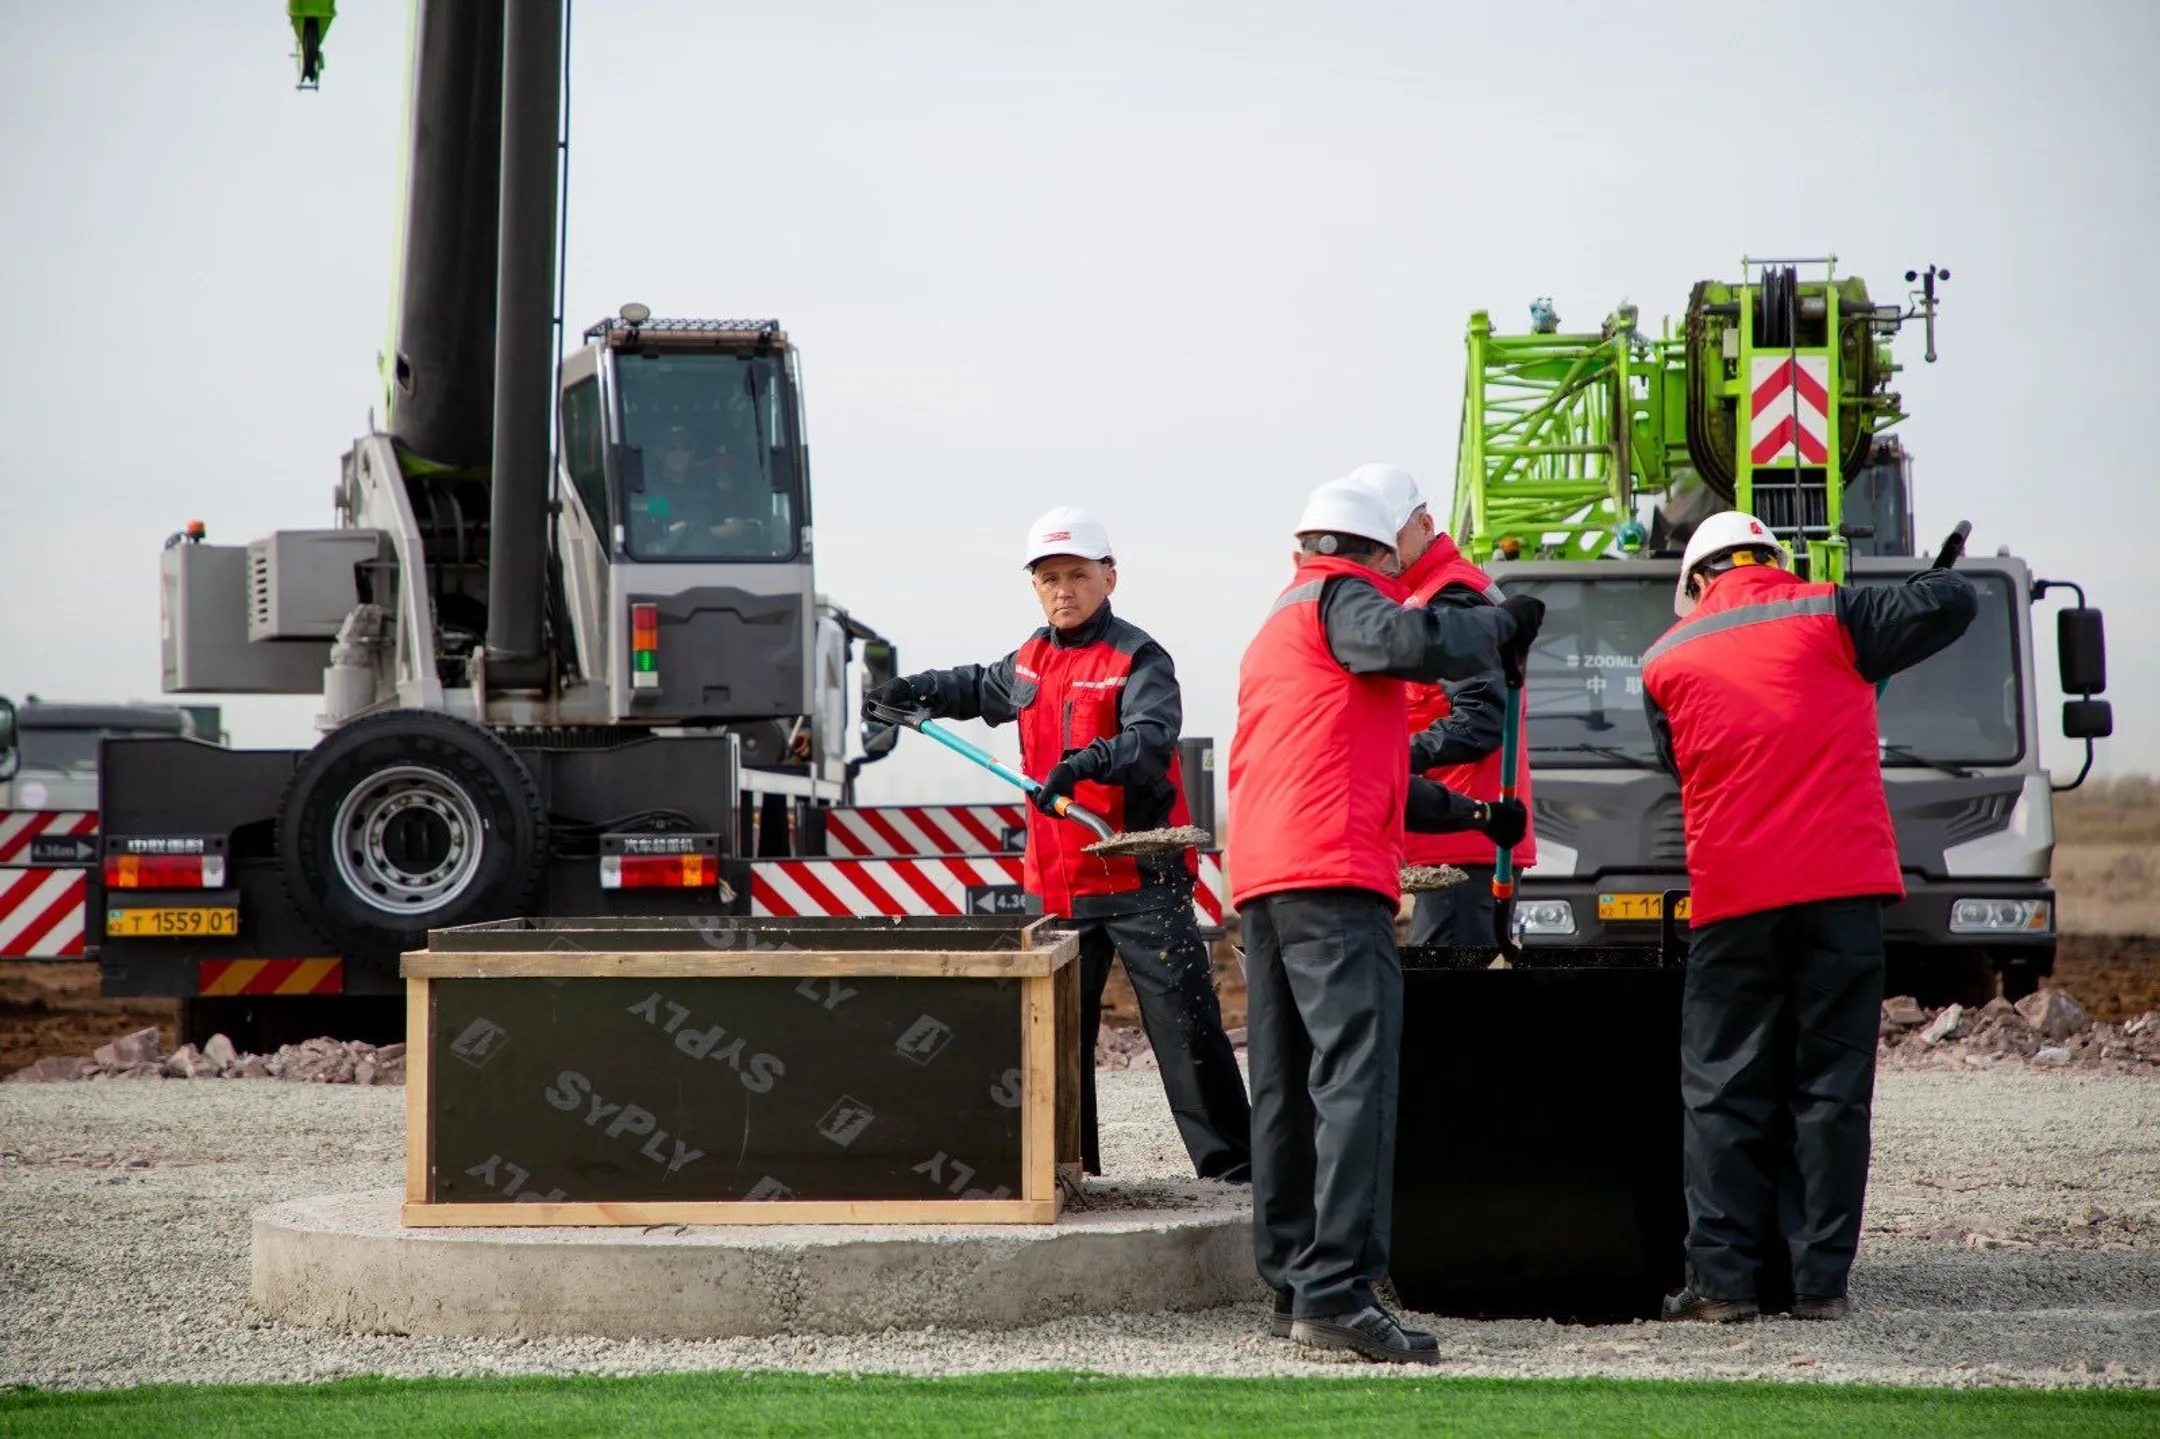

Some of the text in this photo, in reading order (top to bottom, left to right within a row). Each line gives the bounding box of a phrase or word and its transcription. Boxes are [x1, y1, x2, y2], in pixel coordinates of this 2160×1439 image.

[132, 916, 143, 932] T
[152, 911, 202, 932] 1559
[210, 911, 235, 932] 01
[1621, 901, 1633, 916] T
[626, 991, 786, 1094] SYPLY
[544, 1070, 705, 1173] SYPLY
